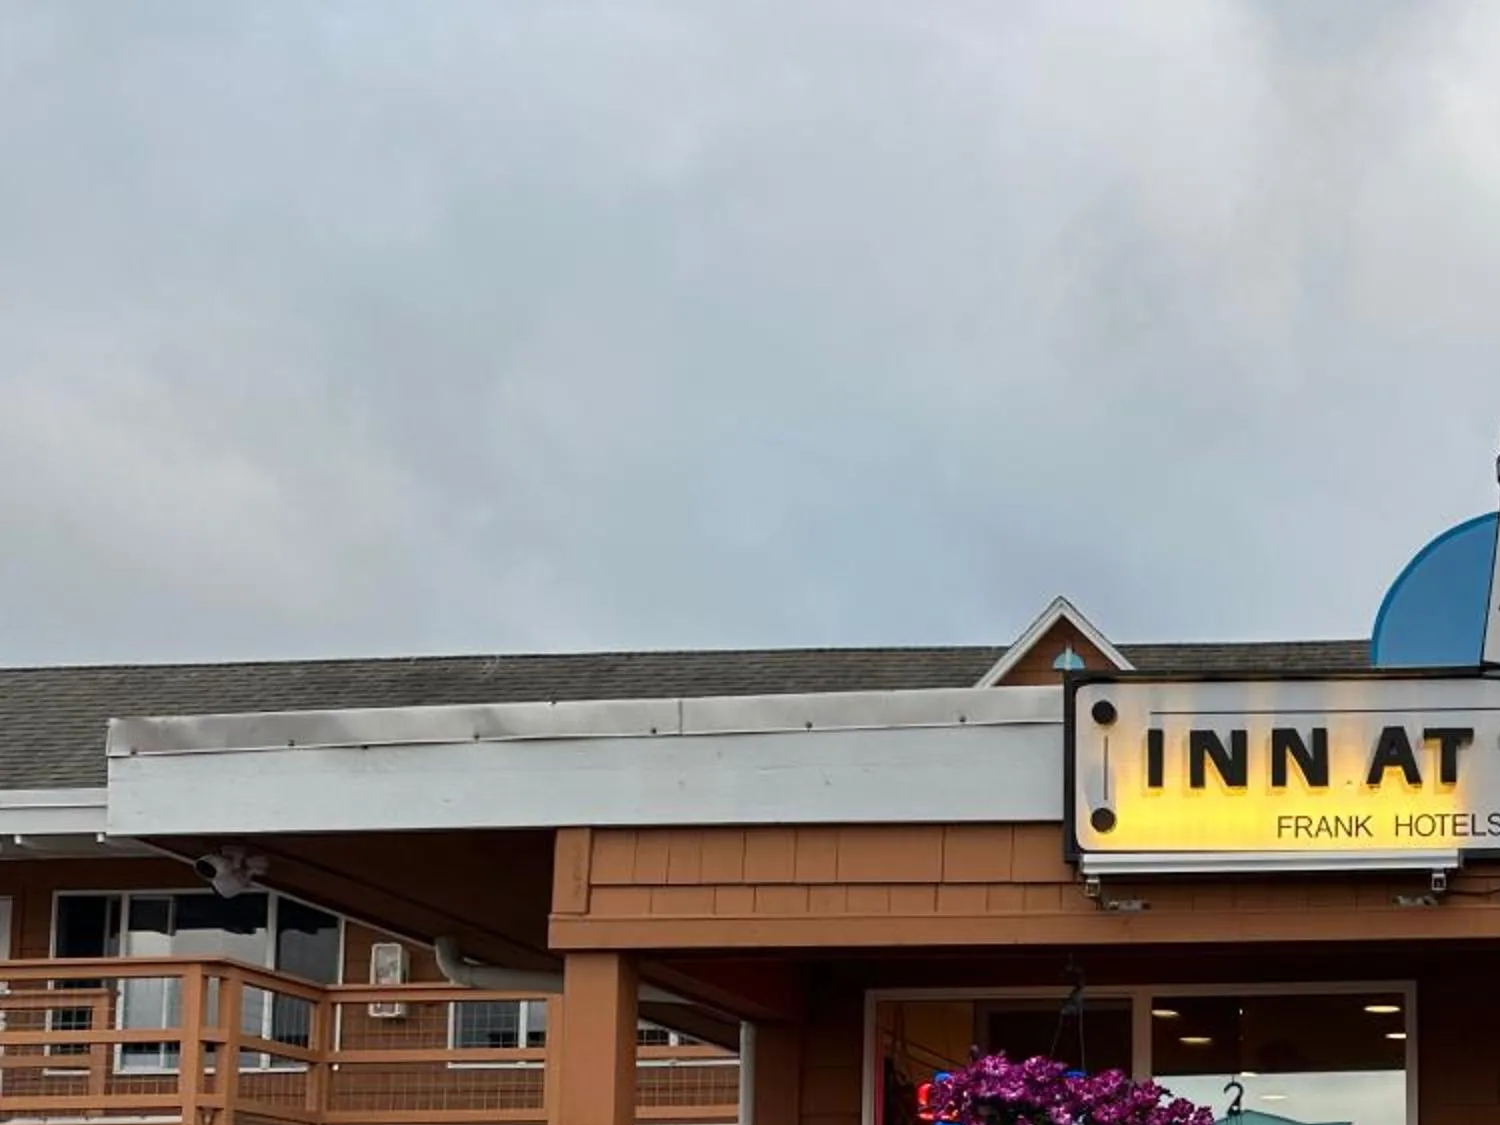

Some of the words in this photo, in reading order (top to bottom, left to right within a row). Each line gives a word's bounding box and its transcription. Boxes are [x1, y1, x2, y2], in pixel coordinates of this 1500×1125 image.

[1146, 727, 1330, 789] INN
[1365, 725, 1475, 787] AT
[1276, 814, 1374, 839] FRANK
